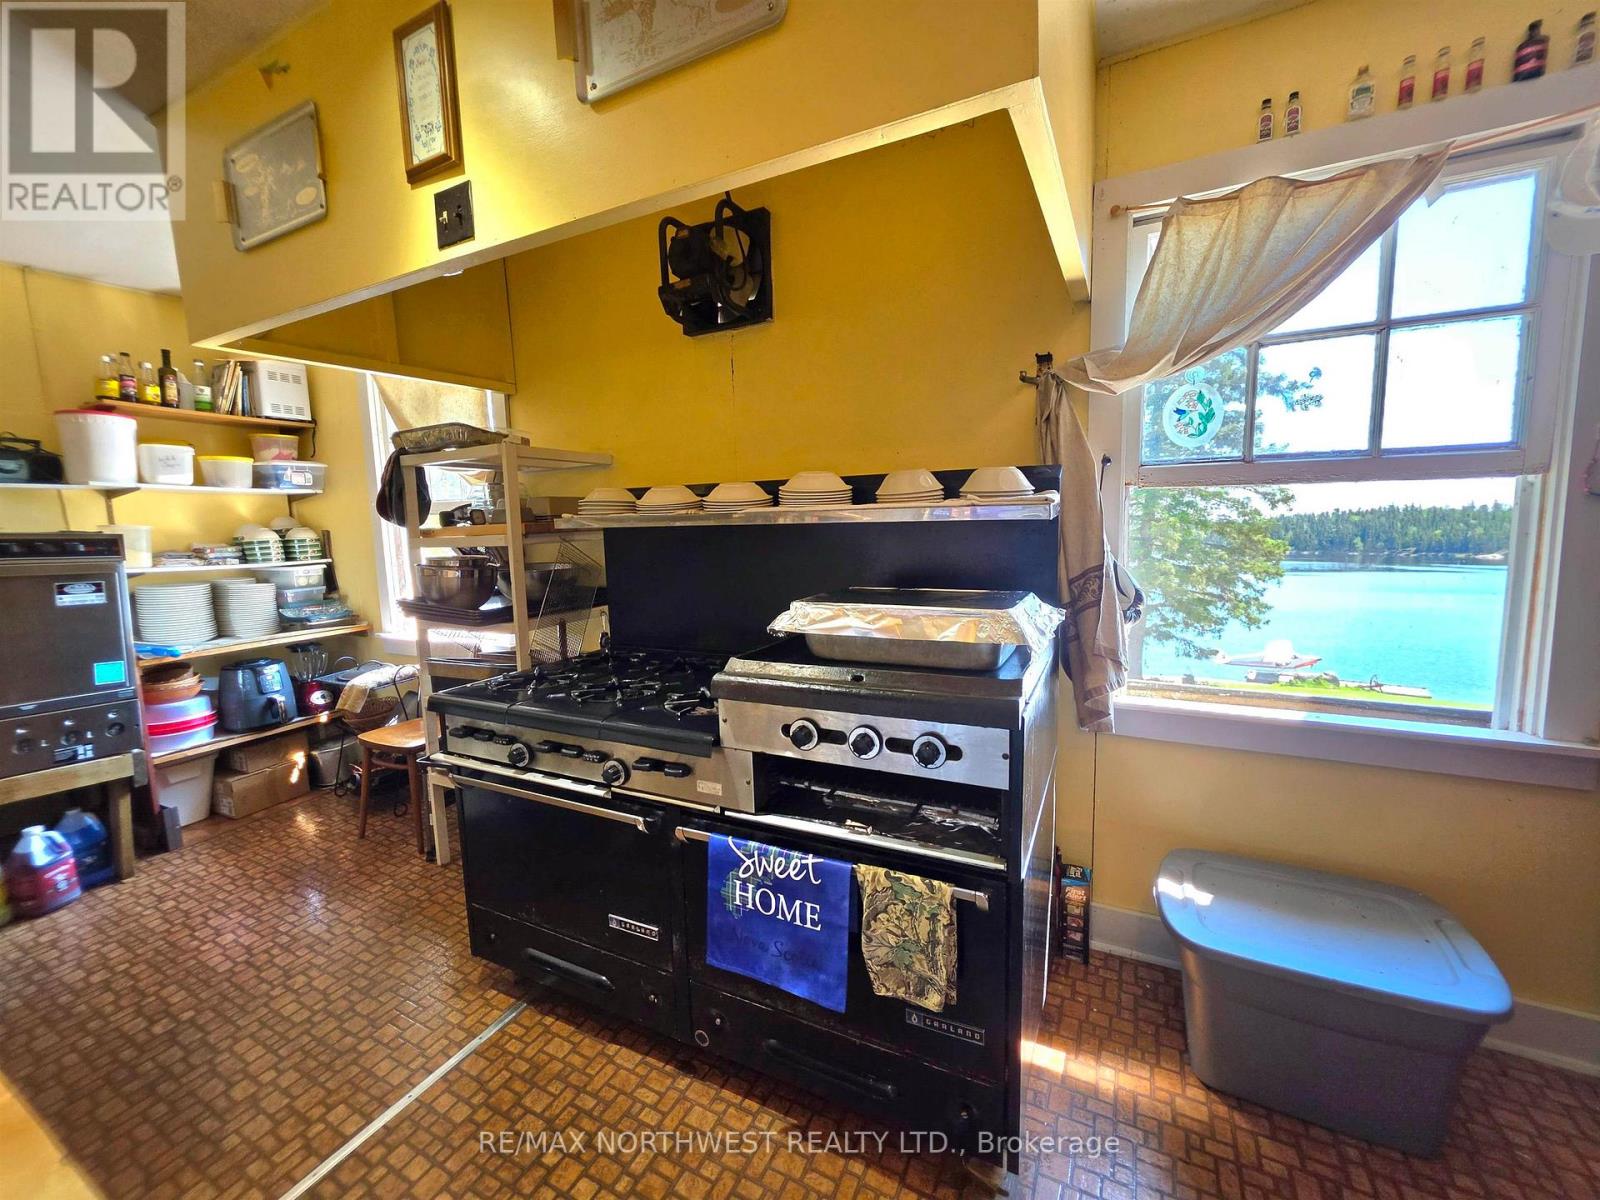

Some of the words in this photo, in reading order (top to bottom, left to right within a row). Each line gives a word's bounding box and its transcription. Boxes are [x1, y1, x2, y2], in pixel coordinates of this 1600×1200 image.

[728, 836, 824, 885] Sweet
[734, 879, 822, 931] HOME
[925, 1018, 980, 1040] GARLAND
